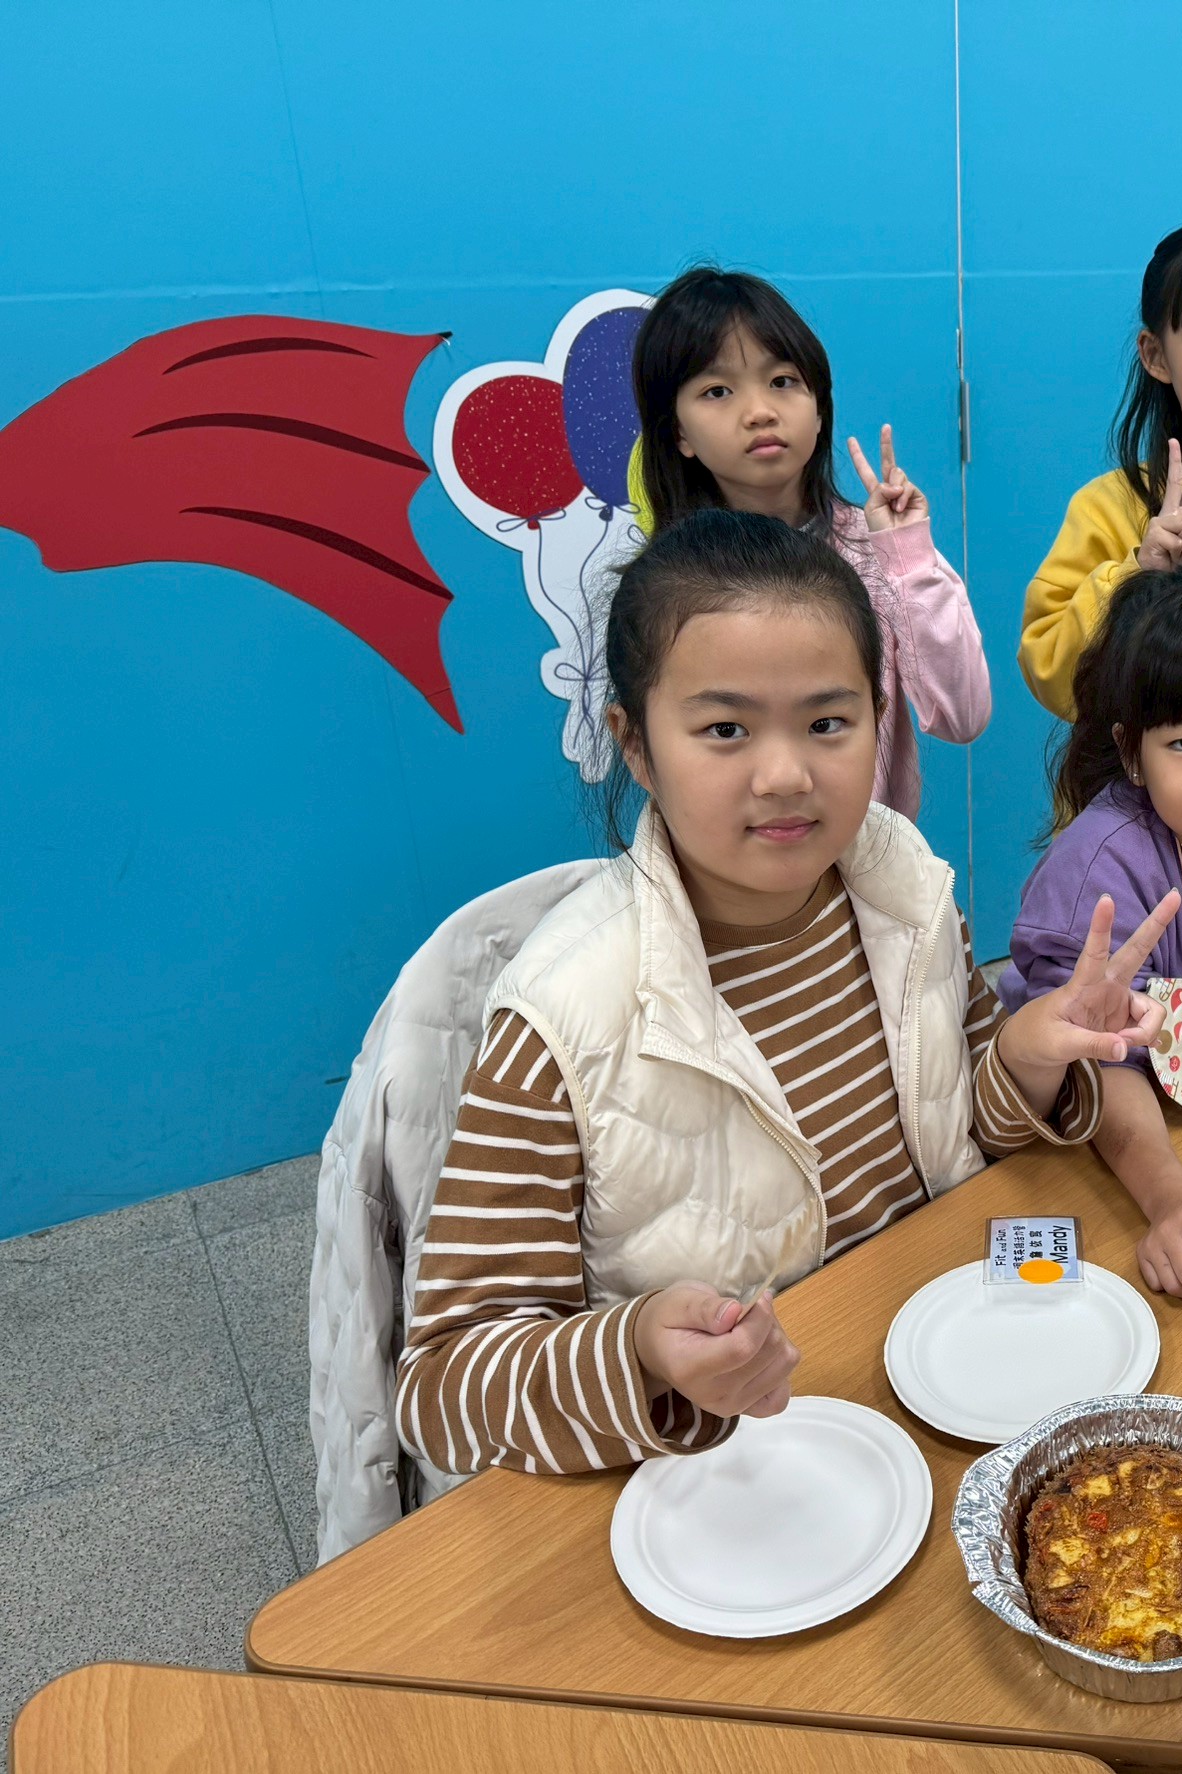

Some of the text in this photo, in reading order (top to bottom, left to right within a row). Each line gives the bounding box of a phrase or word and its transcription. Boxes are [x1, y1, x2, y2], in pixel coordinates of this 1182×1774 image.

[996, 1229, 1007, 1241] Fun
[1048, 1225, 1072, 1263] Mandy
[995, 1255, 1006, 1266] Fit
